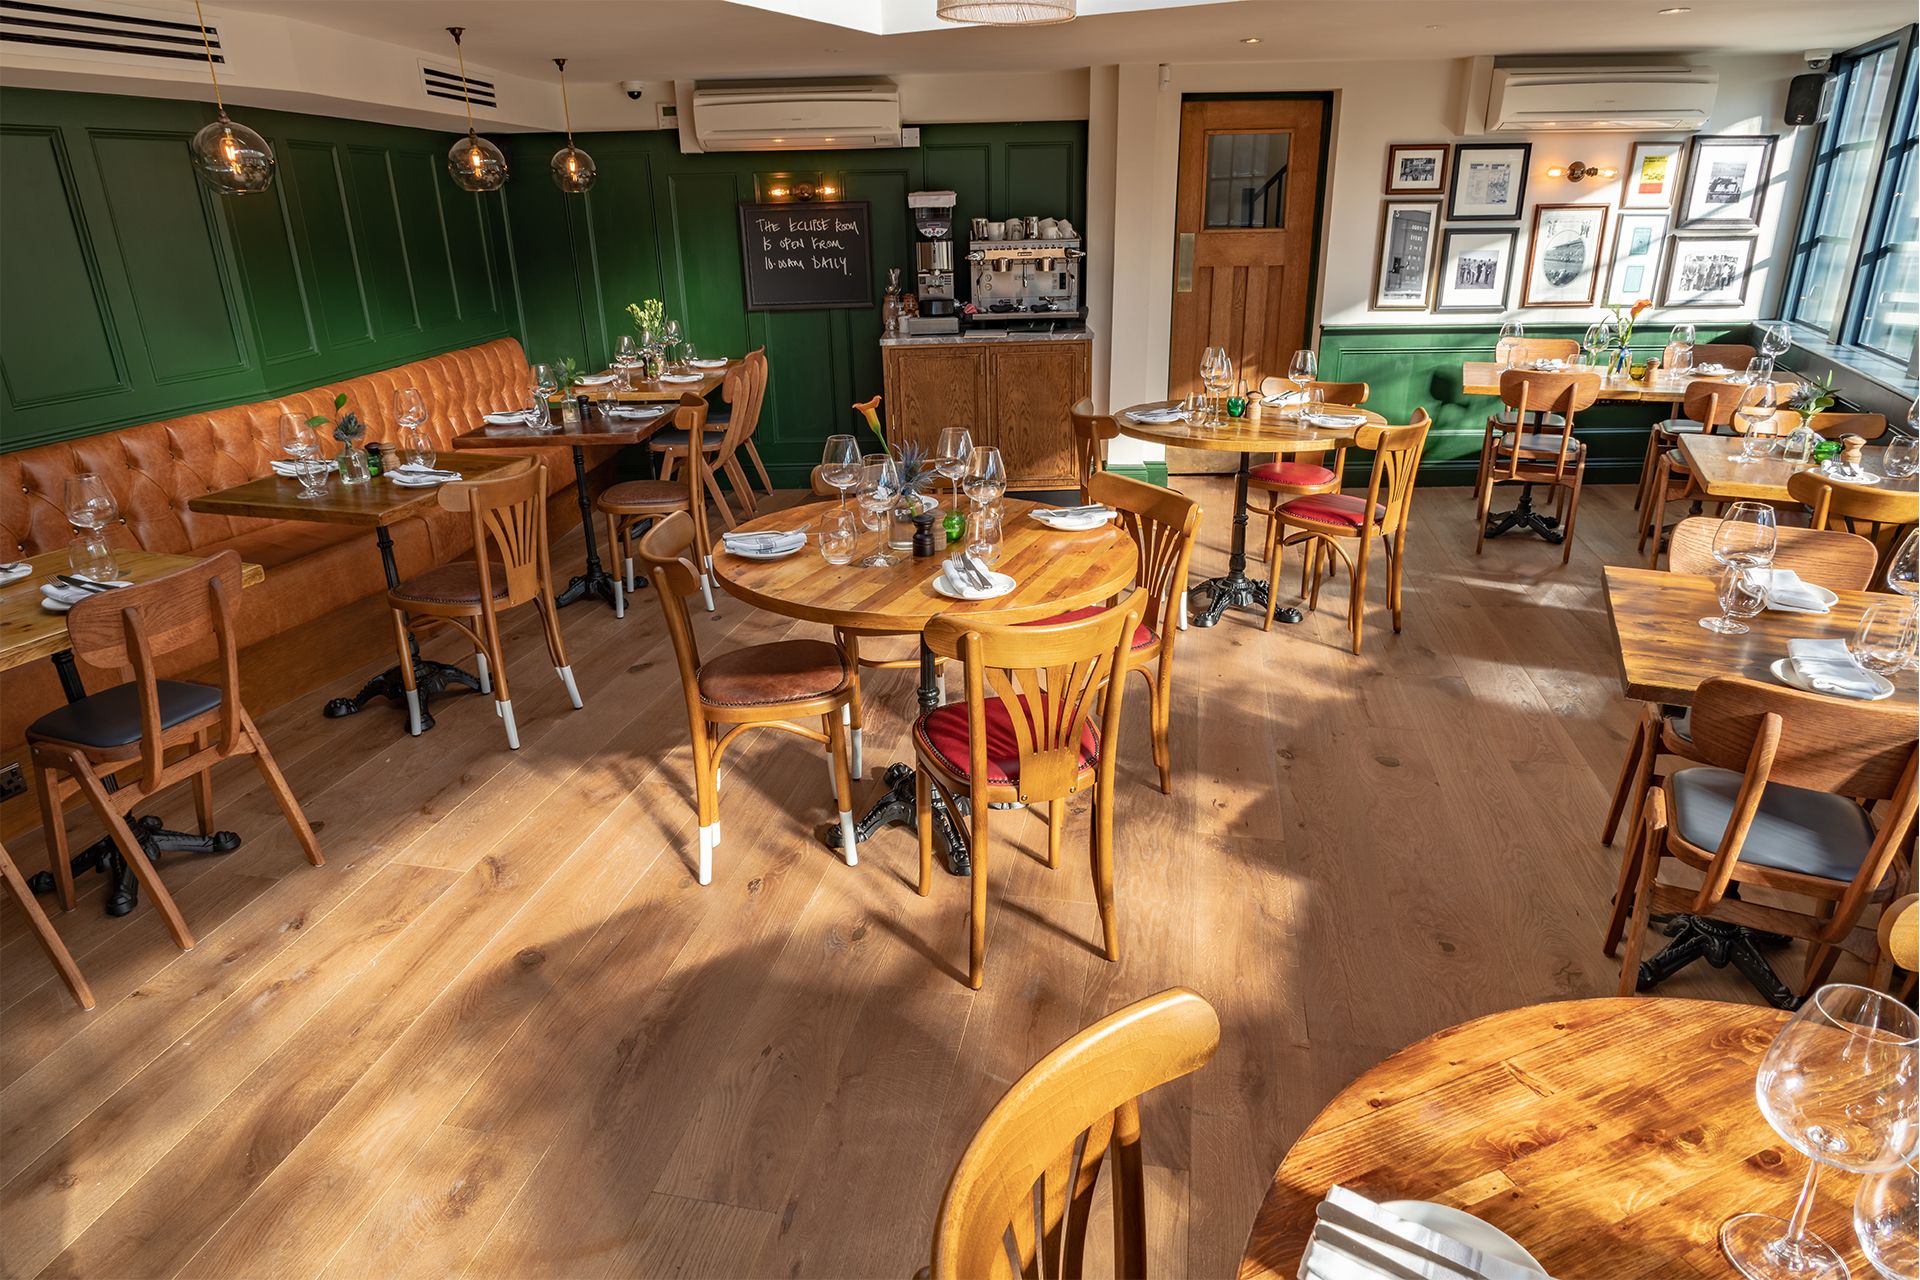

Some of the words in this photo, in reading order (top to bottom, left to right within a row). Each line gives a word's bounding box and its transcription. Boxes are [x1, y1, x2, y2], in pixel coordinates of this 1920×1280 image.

[755, 218, 780, 232] THE
[789, 217, 830, 232] ECLIPSE
[763, 236, 772, 251] IS
[779, 237, 805, 250] OPEN
[811, 236, 845, 250] FROM
